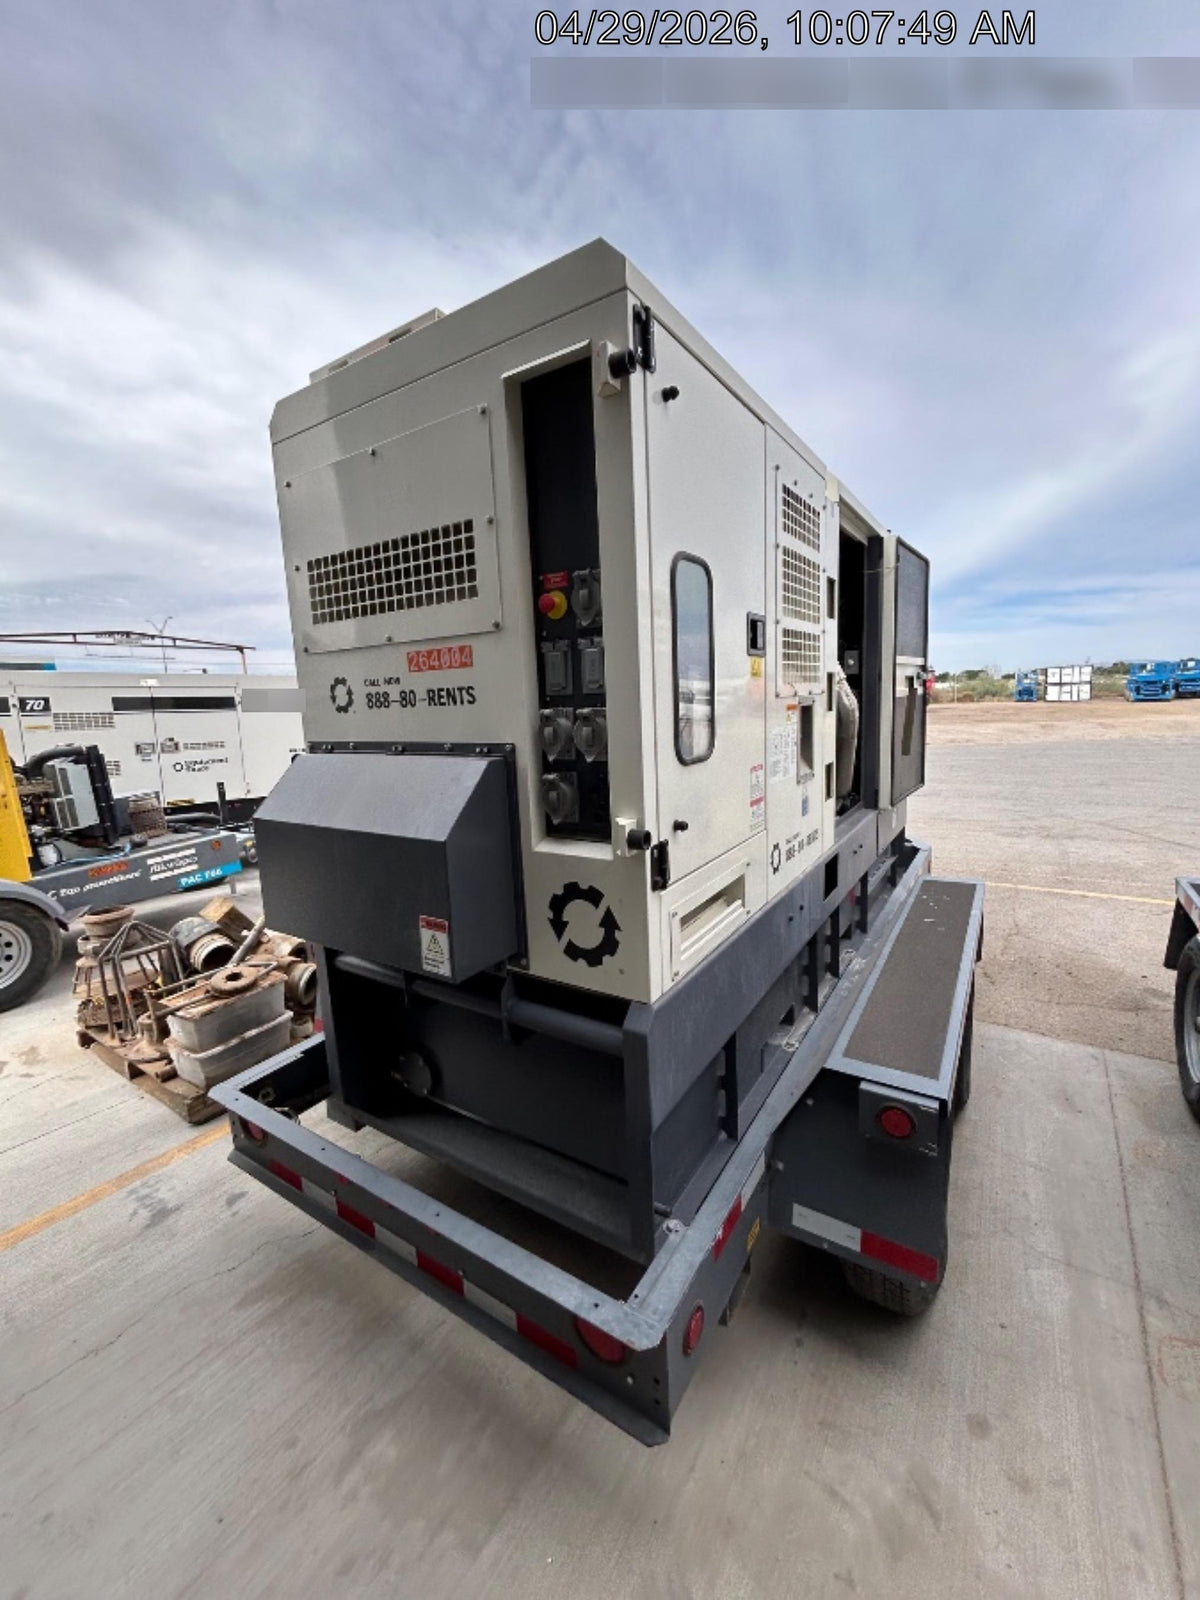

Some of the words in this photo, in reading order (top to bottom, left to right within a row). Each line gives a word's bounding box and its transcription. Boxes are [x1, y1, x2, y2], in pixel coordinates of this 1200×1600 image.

[408, 646, 472, 671] 264004
[25, 700, 45, 711] 70
[181, 874, 202, 886] PAC
